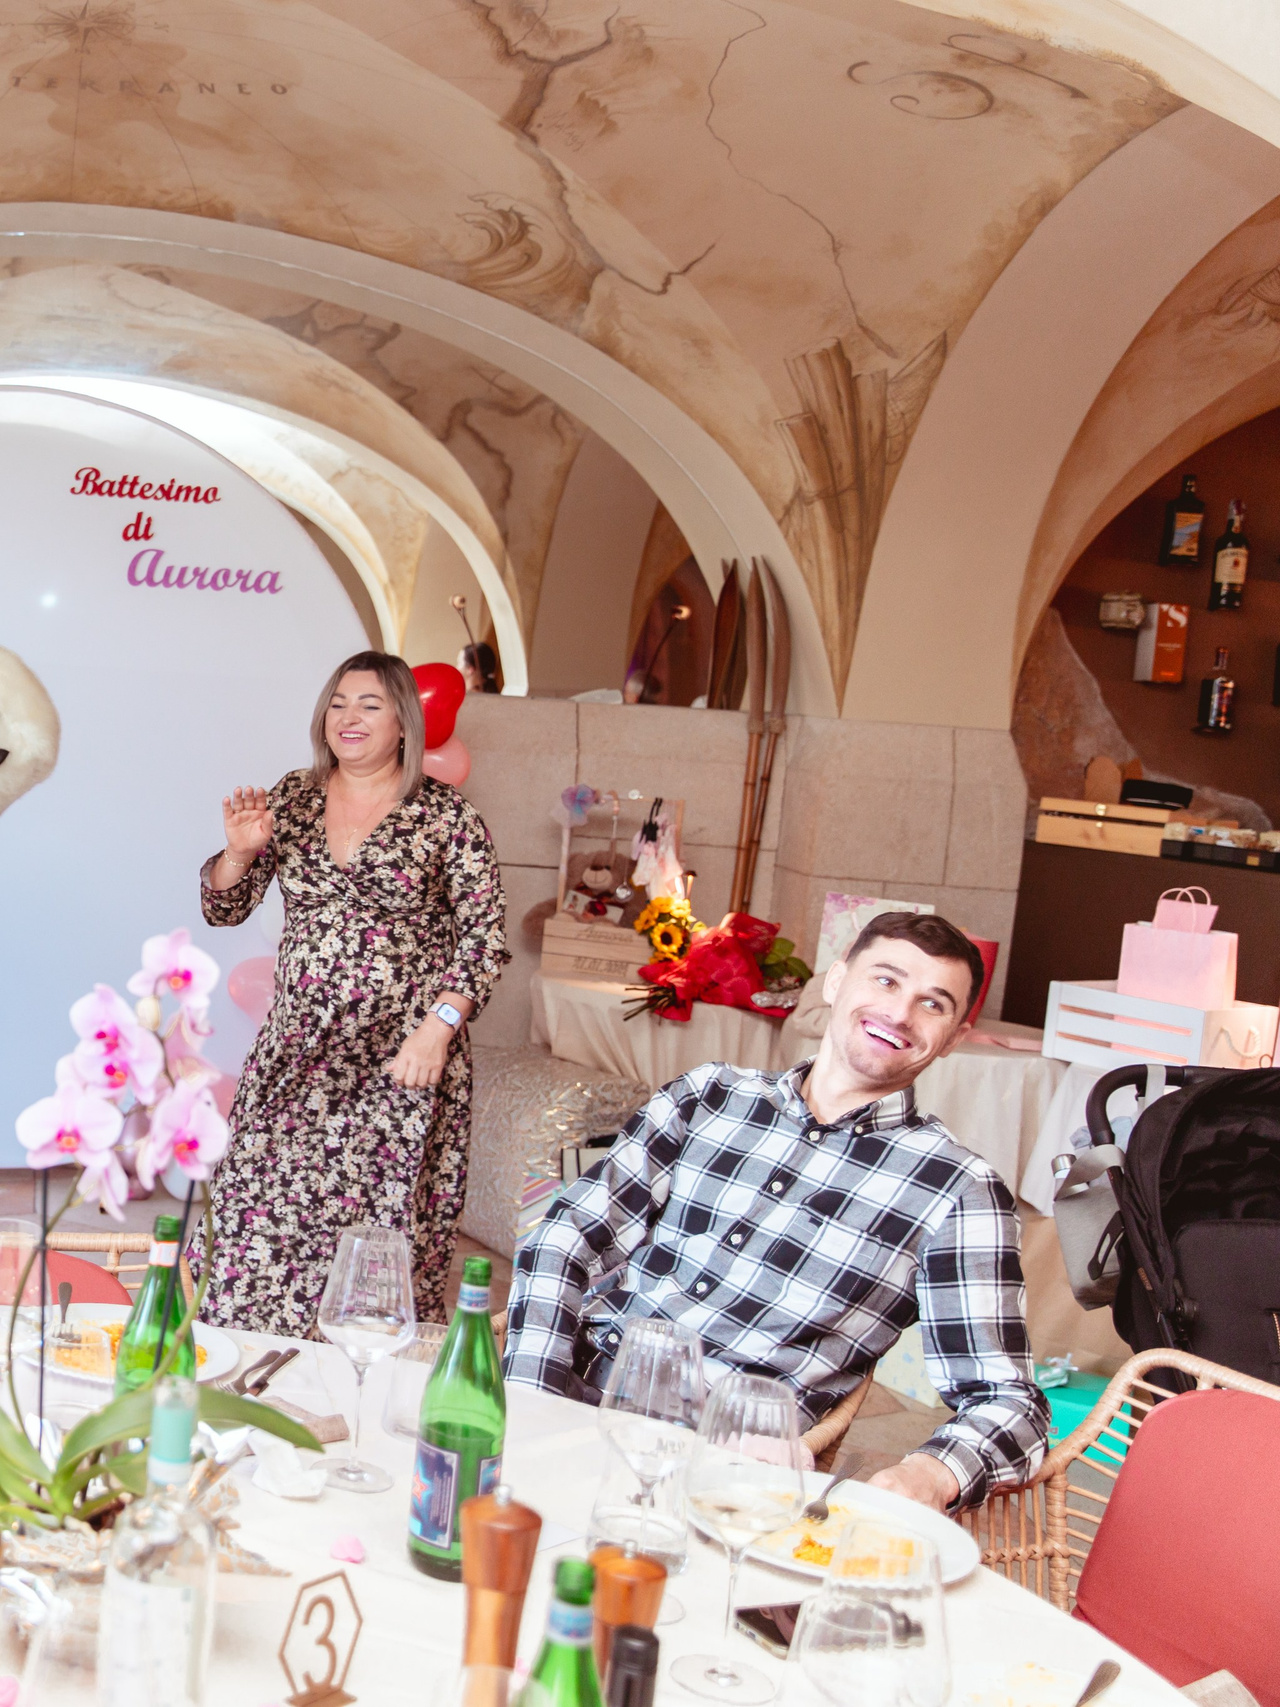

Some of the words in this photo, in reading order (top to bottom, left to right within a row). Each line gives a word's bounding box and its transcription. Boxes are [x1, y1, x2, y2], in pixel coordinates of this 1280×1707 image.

[70, 467, 221, 504] Battesimo
[122, 511, 154, 541] di
[127, 548, 283, 594] Aurora
[302, 1593, 337, 1688] 3
